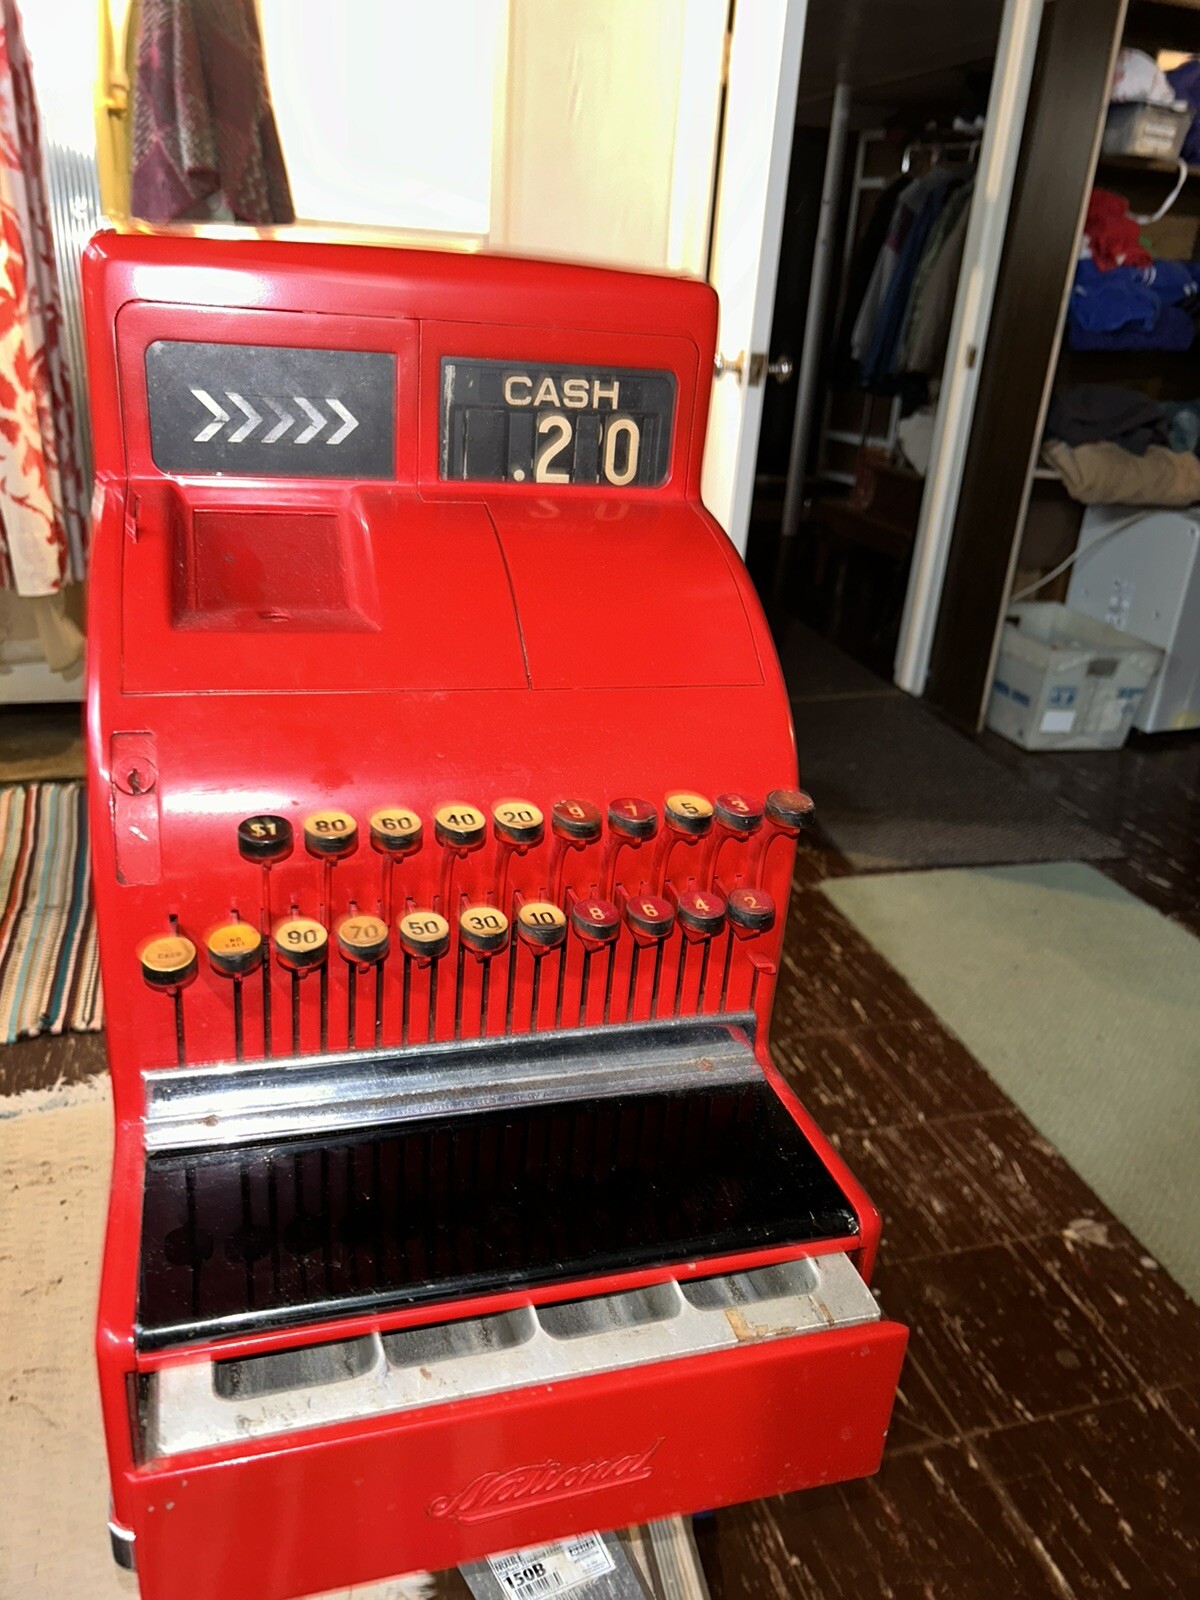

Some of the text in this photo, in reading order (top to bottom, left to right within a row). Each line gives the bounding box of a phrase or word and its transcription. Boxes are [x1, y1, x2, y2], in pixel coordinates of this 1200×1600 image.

[504, 376, 620, 409] CASH
[568, 807, 586, 819] 9
[624, 805, 638, 817] 7
[681, 802, 699, 815] 5
[732, 800, 750, 812] 3
[381, 817, 412, 831] 60
[447, 813, 476, 826] 40
[503, 810, 534, 824] 20
[250, 823, 277, 838] $1
[315, 819, 346, 833] 80
[695, 899, 710, 912] 4
[744, 896, 761, 909] 2
[589, 907, 605, 920] 8
[642, 904, 659, 917] 6
[470, 915, 500, 930] 30
[530, 911, 556, 926] 10
[350, 924, 378, 940] 70
[408, 920, 440, 936] 50
[287, 929, 317, 944] 90
[427, 1436, 666, 1518] National
[503, 1562, 546, 1589] 150B
